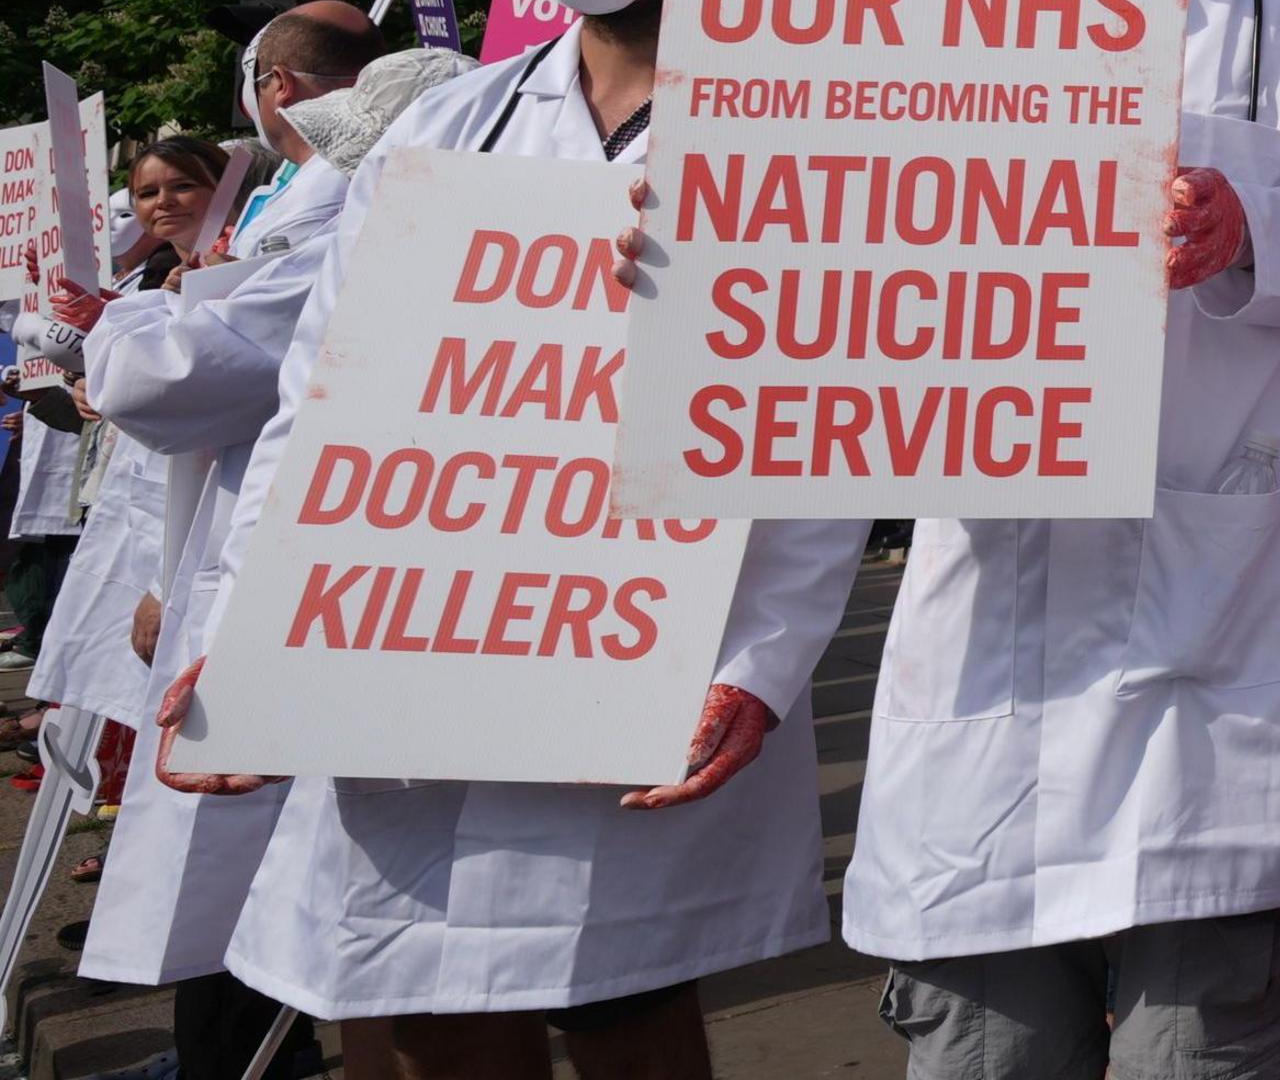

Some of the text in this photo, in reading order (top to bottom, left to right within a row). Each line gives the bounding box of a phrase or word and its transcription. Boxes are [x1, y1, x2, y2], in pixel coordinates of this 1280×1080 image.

[689, 77, 1143, 125] FROM BECOMING THE
[2, 178, 34, 205] MAK
[4, 147, 34, 173] DON
[675, 153, 1140, 247] NATIONAL
[453, 229, 636, 313] DON
[704, 268, 1091, 360] SUICIDE
[418, 337, 625, 423] MAK
[682, 384, 1092, 478] SERVICE
[285, 563, 668, 661] KILLERS
